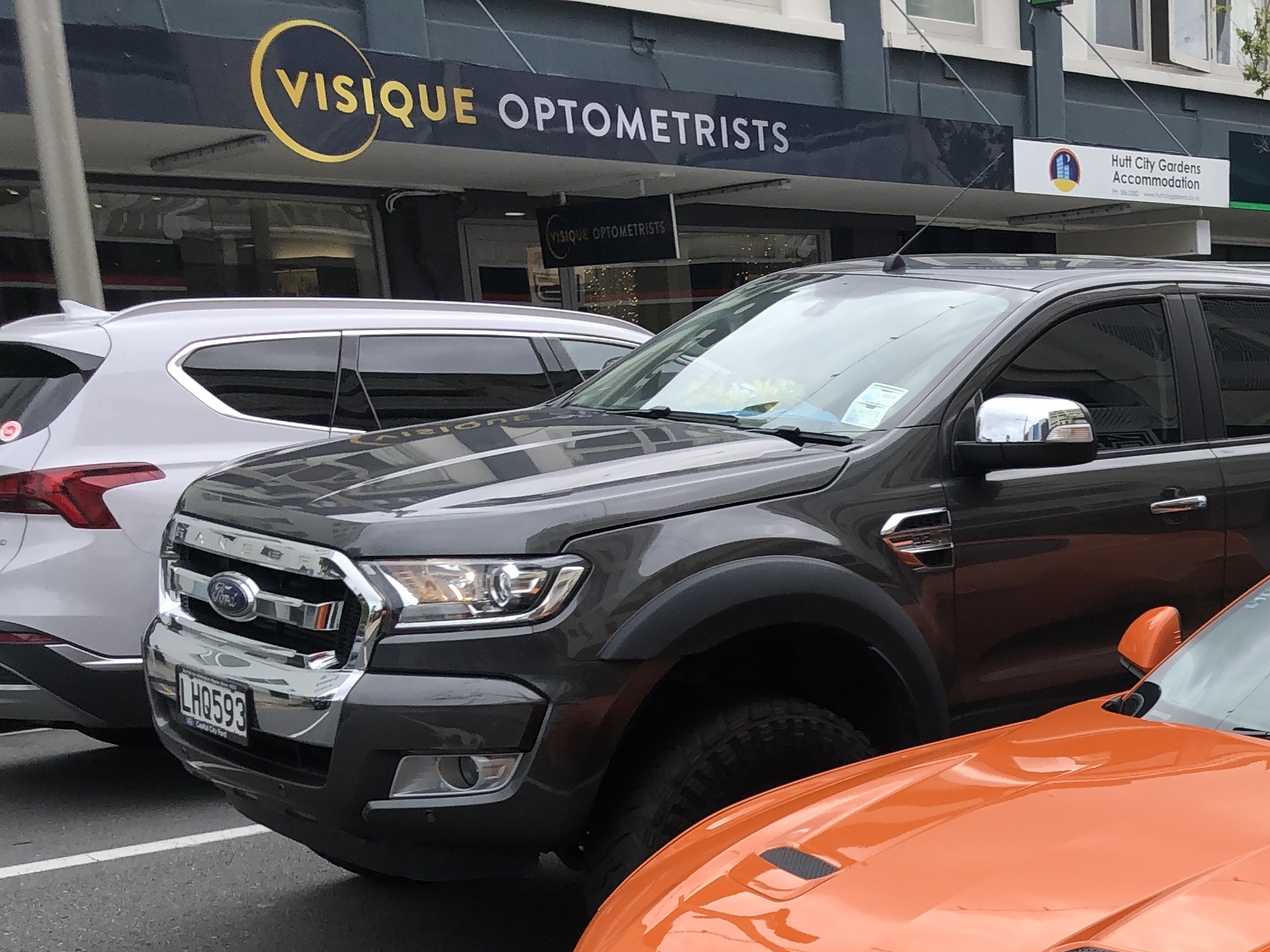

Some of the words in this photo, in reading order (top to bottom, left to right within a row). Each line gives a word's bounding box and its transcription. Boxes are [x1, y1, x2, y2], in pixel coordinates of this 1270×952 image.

[275, 69, 477, 128] VISIQUE
[498, 93, 791, 153] OPTOMETRISTS
[1111, 154, 1132, 168] Hutt
[1135, 156, 1155, 172] City
[1158, 158, 1201, 175] Gardens
[1112, 171, 1200, 189] Accommodation
[550, 228, 589, 246] VISIQUE
[592, 221, 666, 240] OPTOMETRISTS
[211, 582, 239, 608] Ford
[180, 677, 246, 732] LHQ593
